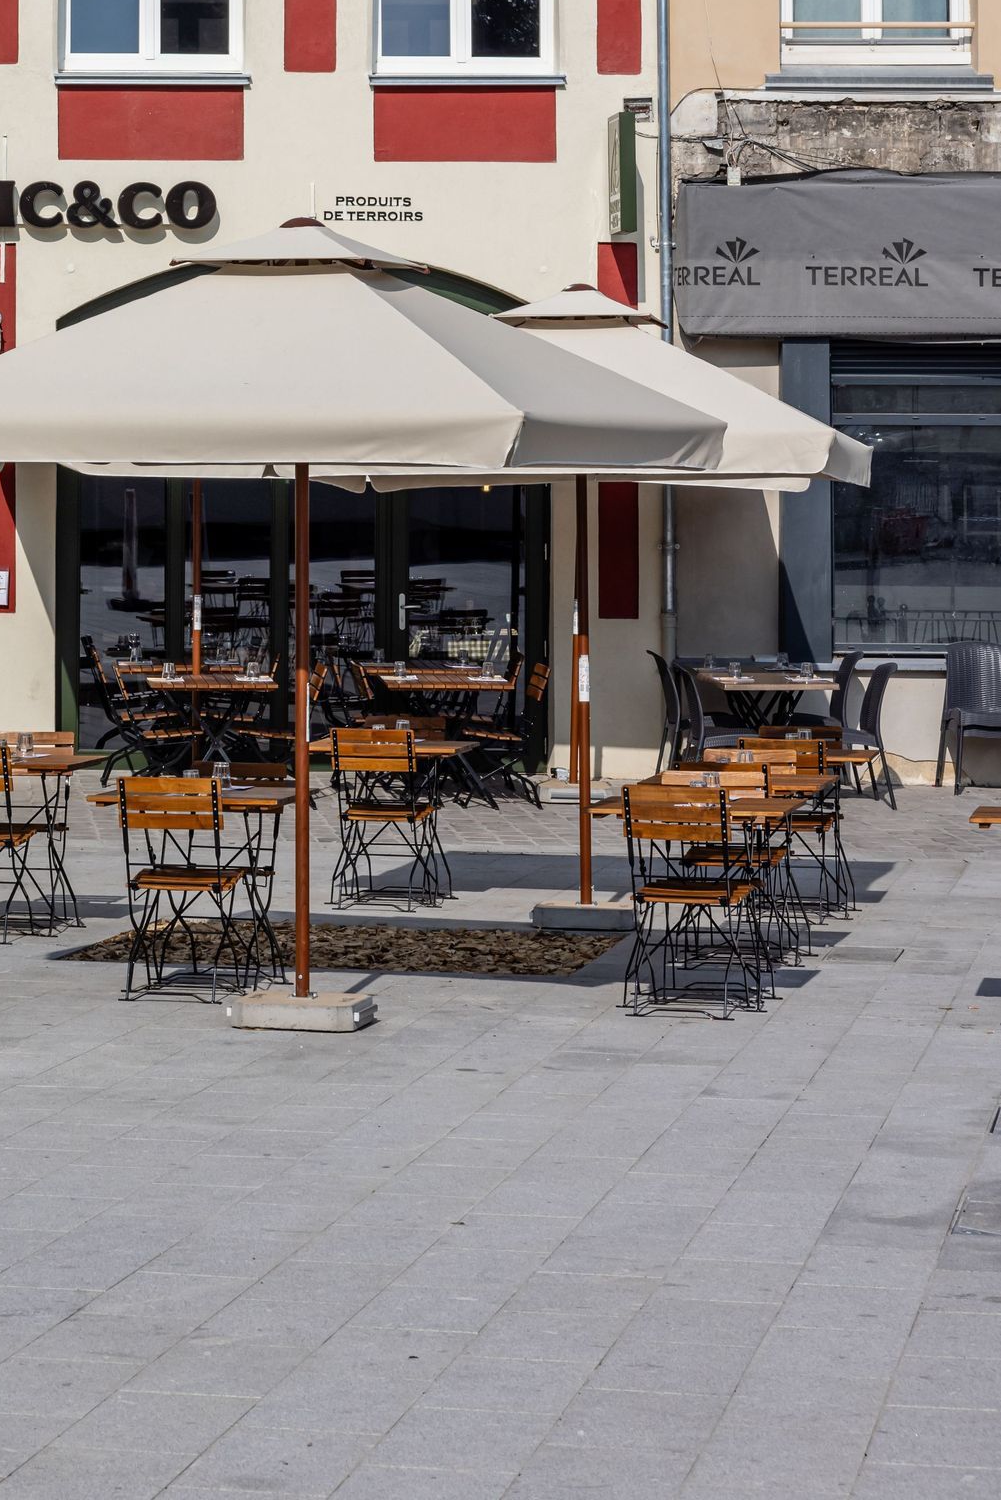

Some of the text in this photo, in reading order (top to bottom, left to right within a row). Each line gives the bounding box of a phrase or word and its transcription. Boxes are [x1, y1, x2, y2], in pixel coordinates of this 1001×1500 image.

[335, 196, 412, 207] PRODUITS
[323, 211, 424, 221] DE TERROIRS
[805, 266, 929, 287] TERREAL
